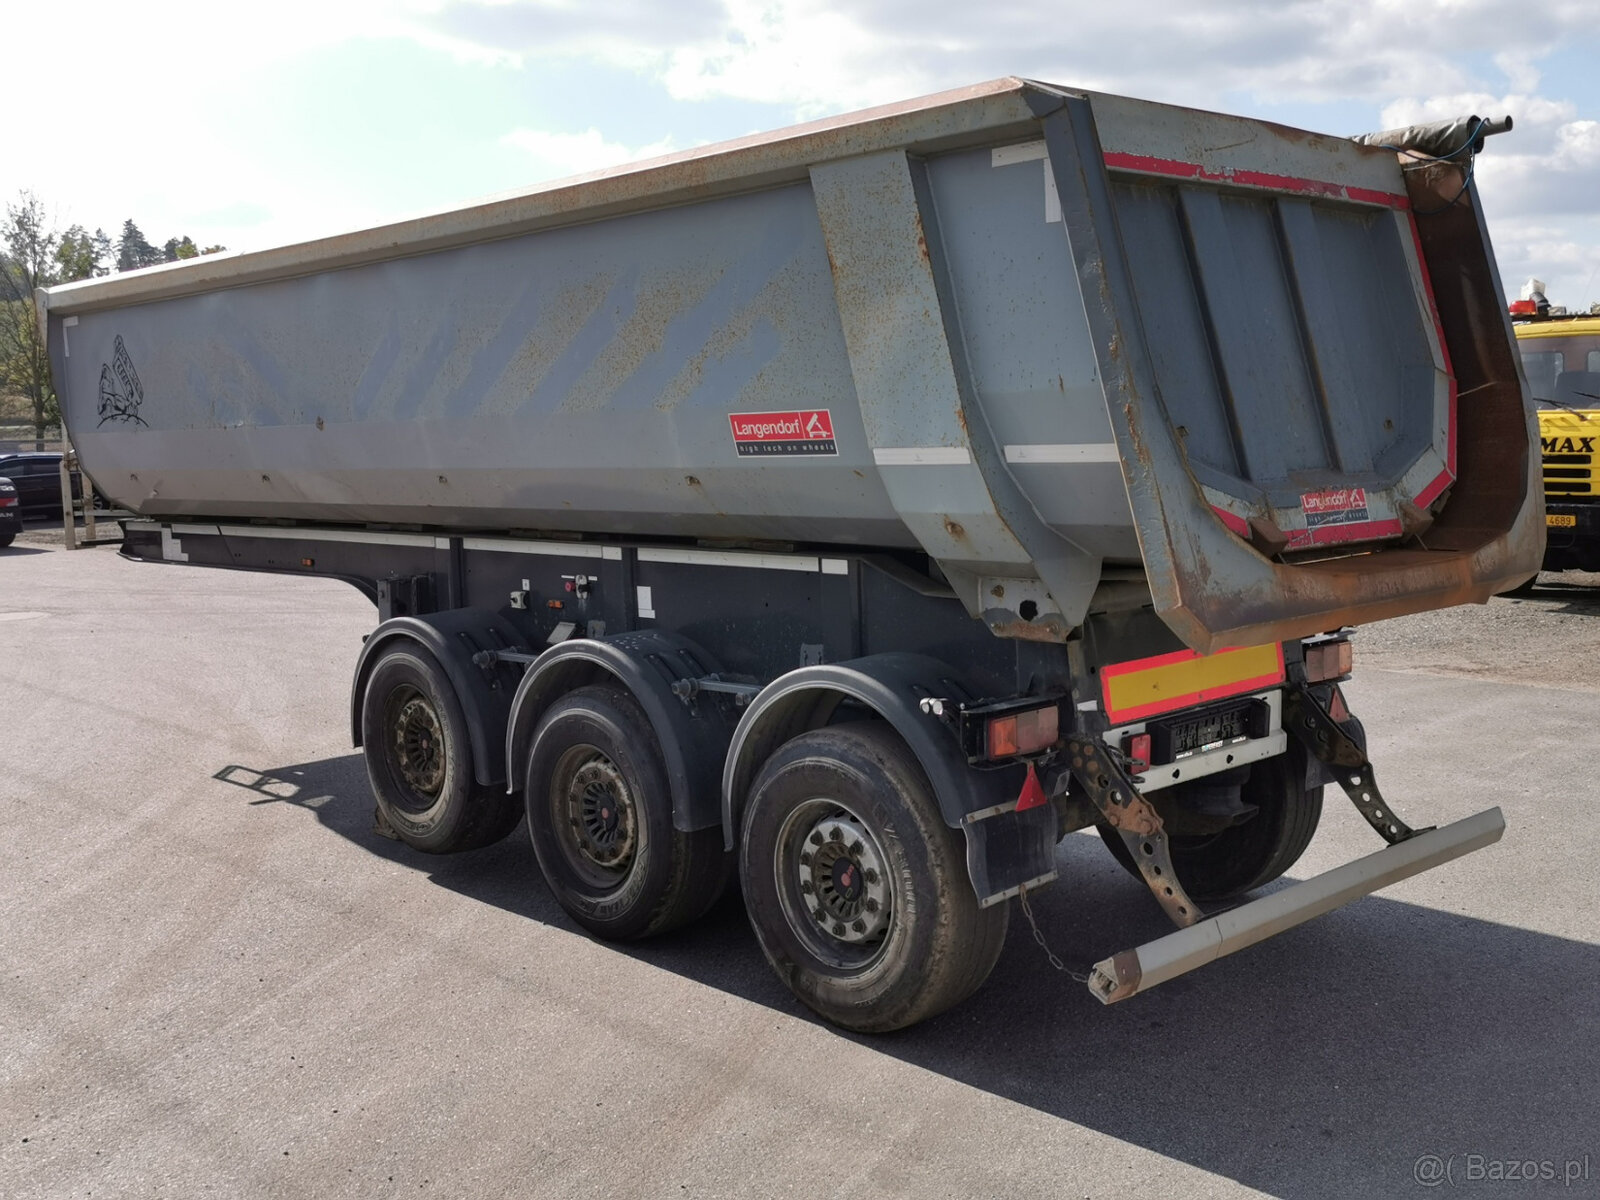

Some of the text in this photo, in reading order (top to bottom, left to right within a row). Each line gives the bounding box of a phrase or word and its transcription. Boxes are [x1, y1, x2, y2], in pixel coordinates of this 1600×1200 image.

[734, 418, 800, 438] Langendorf
[740, 445, 759, 454] high
[802, 444, 835, 452] wheels
[1541, 437, 1596, 453] MAX
[1549, 516, 1571, 526] 4689
